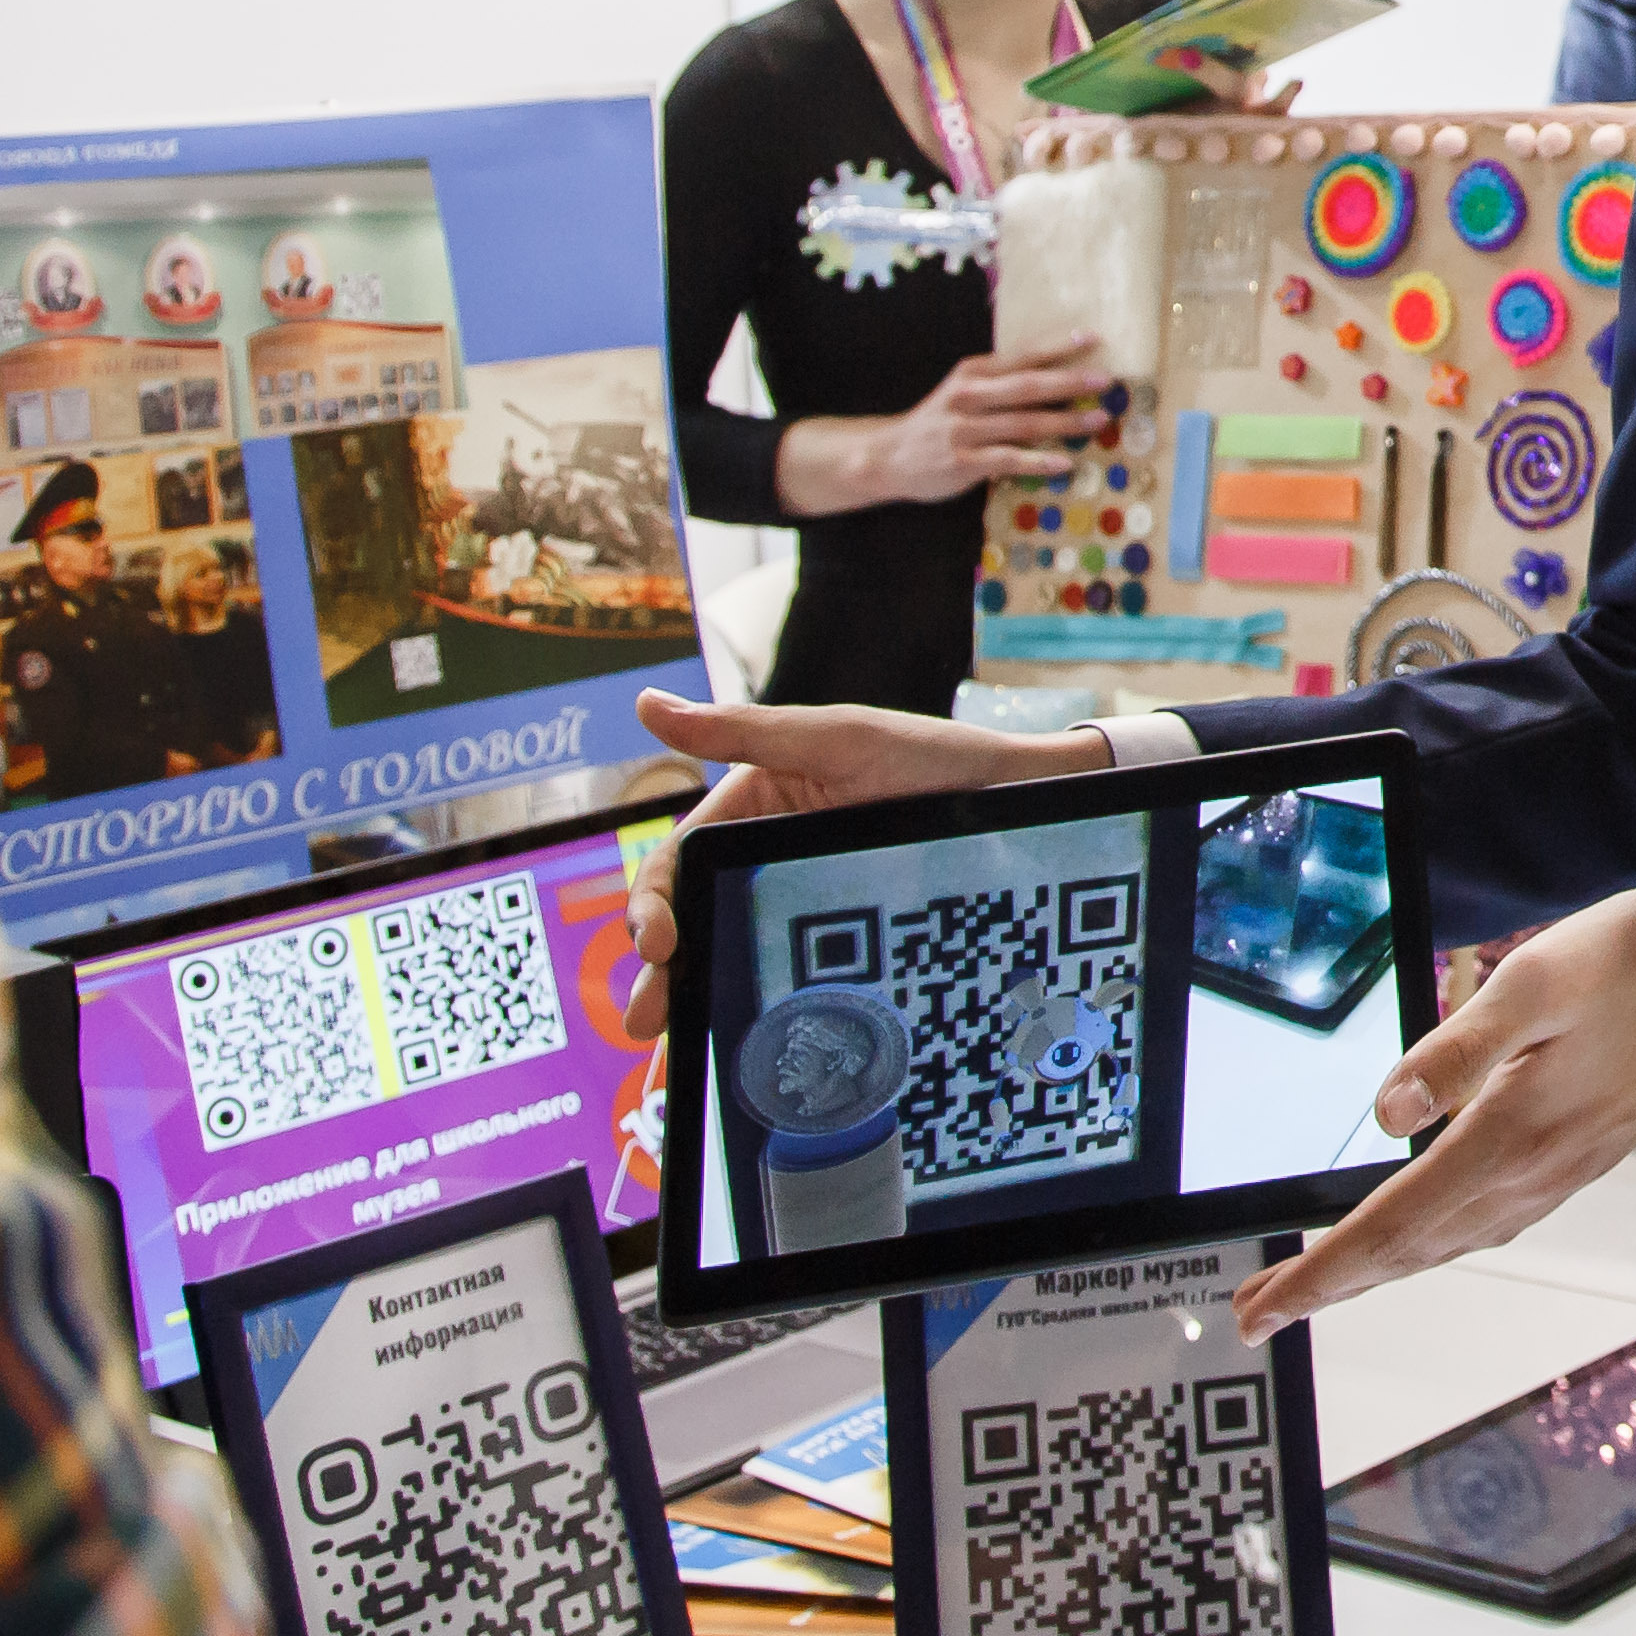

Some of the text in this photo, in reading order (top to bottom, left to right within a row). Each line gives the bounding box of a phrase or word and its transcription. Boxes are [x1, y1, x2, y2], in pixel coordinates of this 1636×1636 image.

[0, 777, 279, 882] СТОРИЮ
[338, 704, 592, 806] ГОЛОВОЙ
[175, 1091, 583, 1235] Приложение для школьного
[352, 1177, 441, 1227] музея
[368, 1263, 506, 1324] Контактная
[1034, 1253, 1221, 1298] Маркер музея
[374, 1299, 525, 1366] информация
